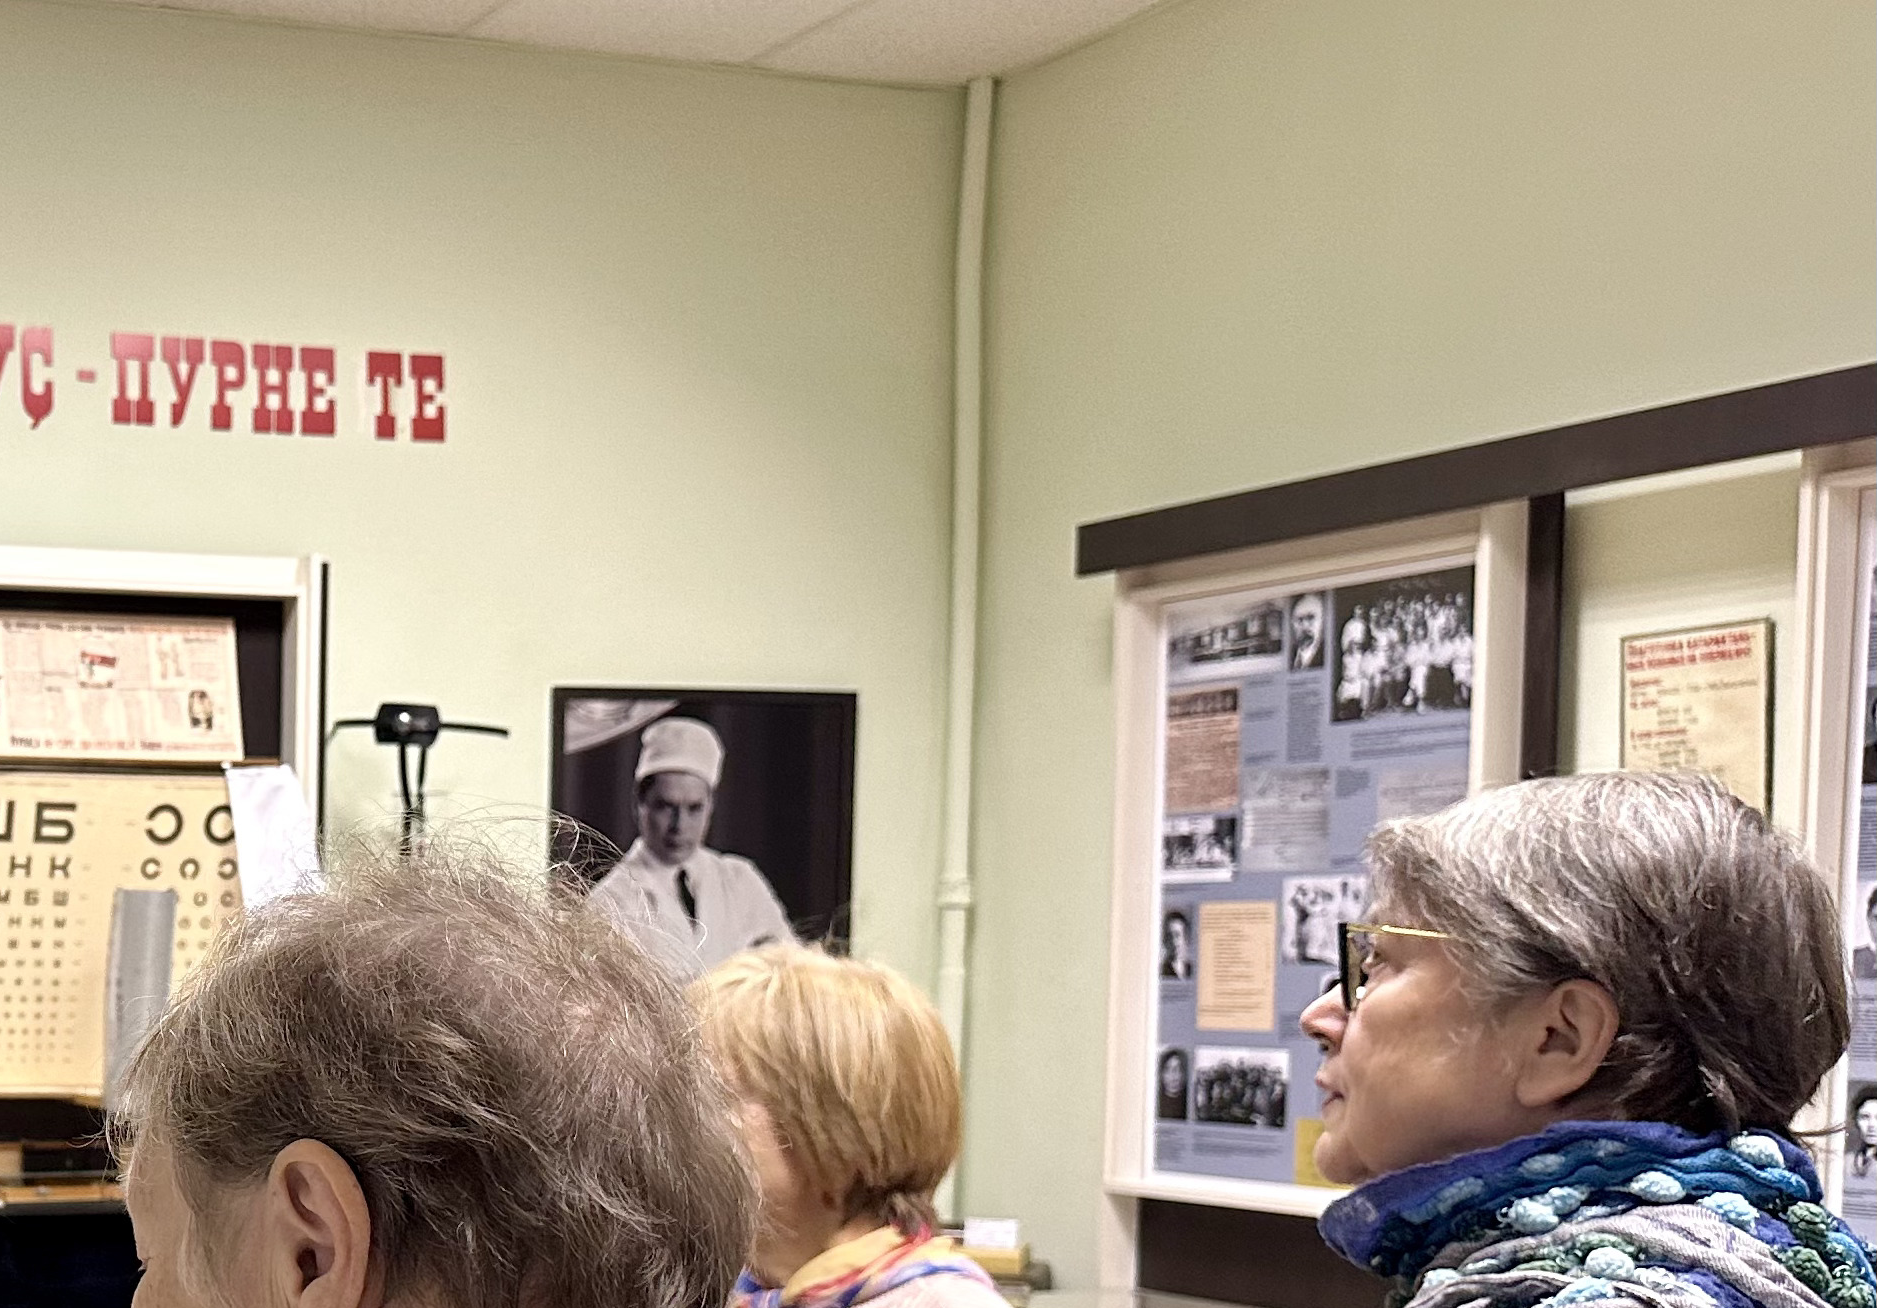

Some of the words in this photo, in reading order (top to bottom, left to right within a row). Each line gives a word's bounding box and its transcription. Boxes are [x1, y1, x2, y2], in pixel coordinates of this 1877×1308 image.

[110, 330, 337, 438] ПУРНЕ
[365, 348, 448, 444] ТЕ
[33, 801, 78, 846] Б
[9, 855, 33, 878] Н
[48, 856, 73, 879] К
